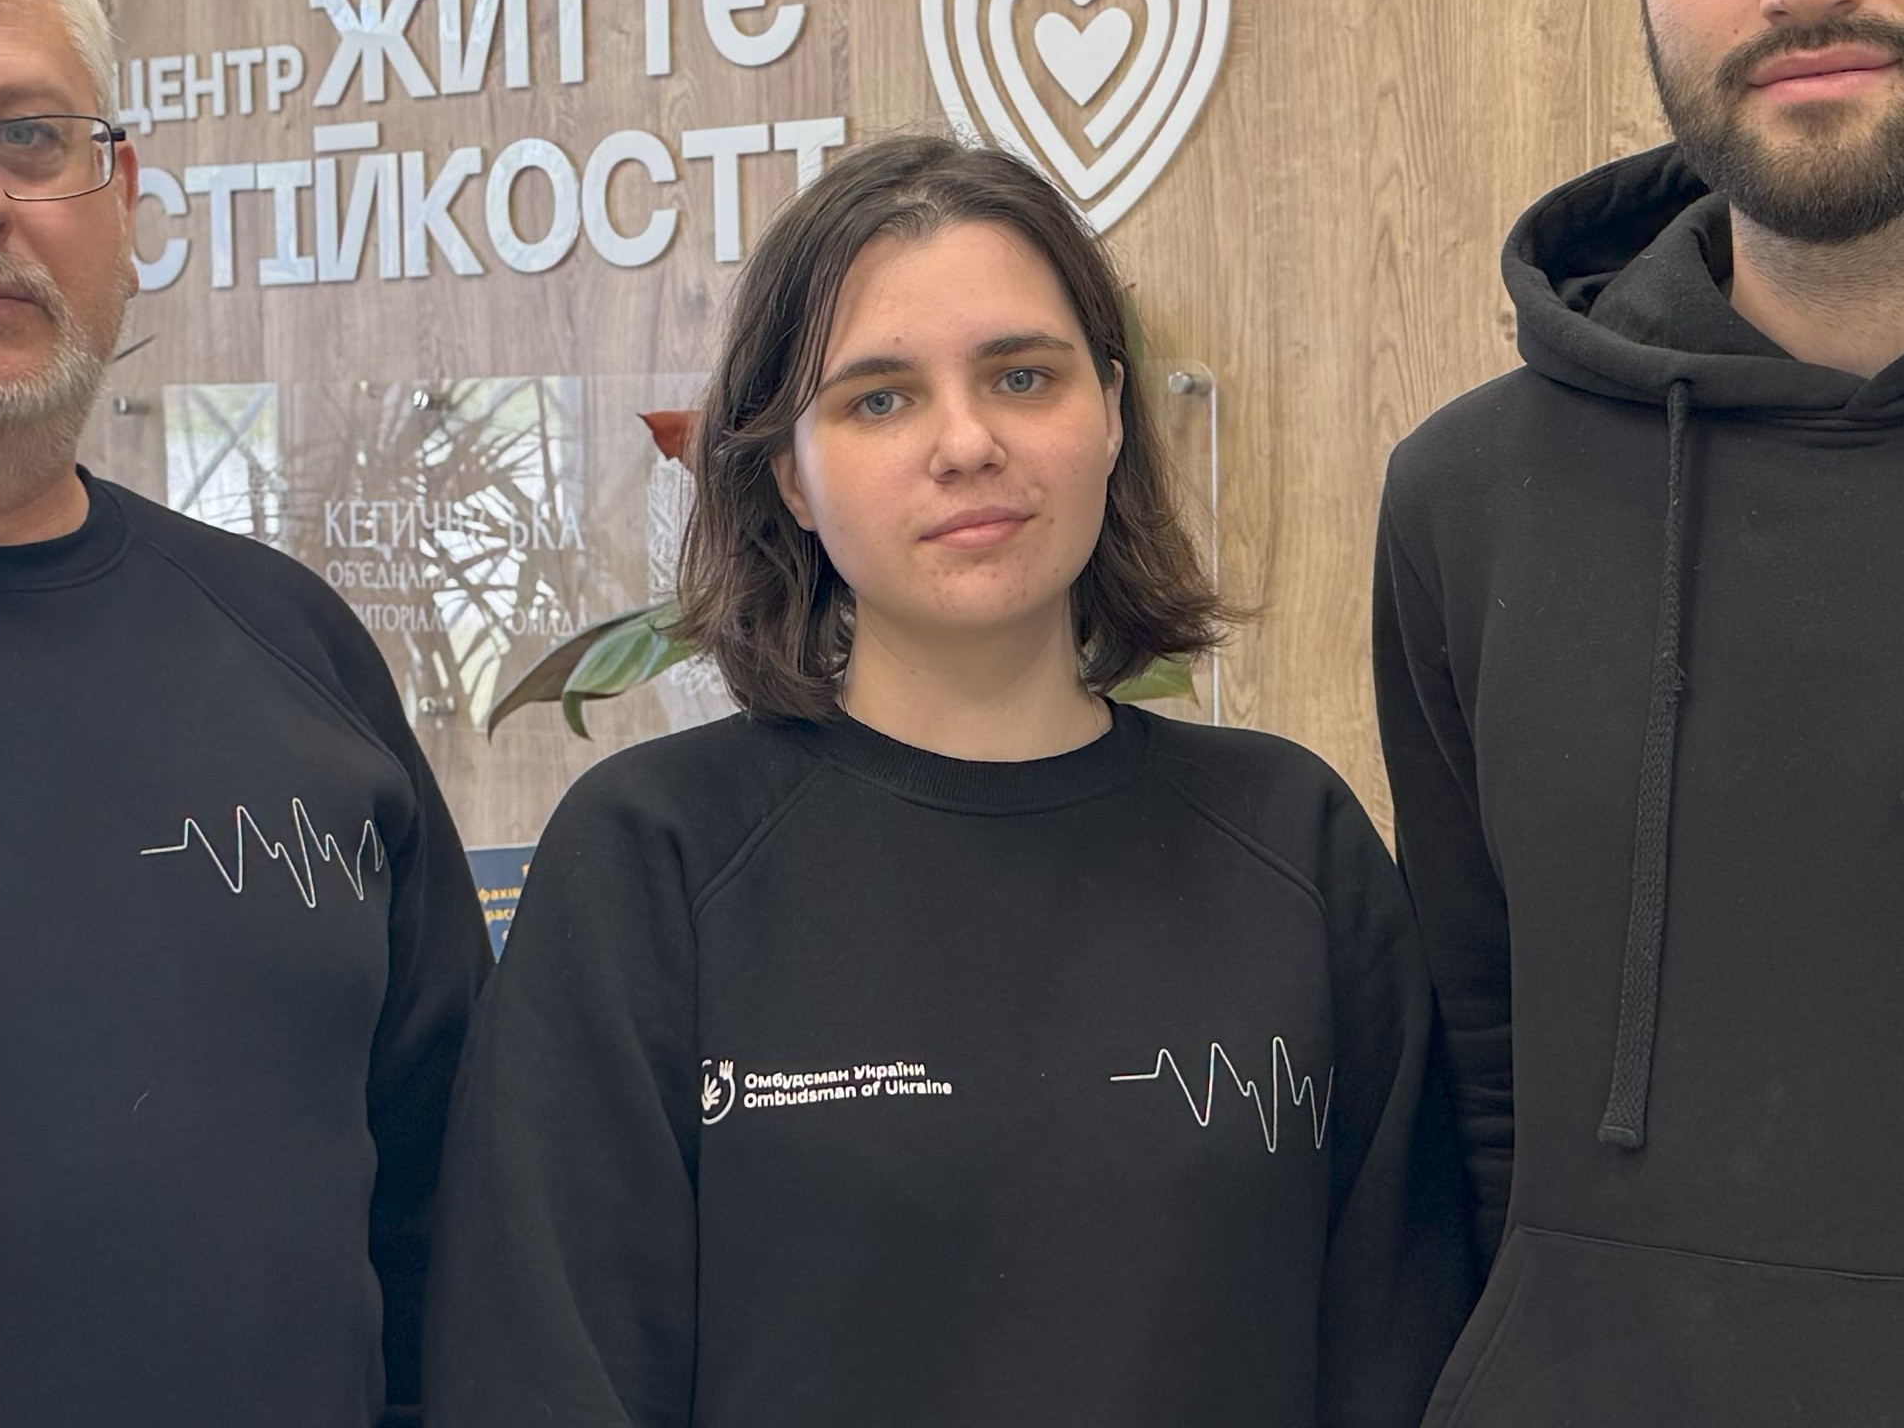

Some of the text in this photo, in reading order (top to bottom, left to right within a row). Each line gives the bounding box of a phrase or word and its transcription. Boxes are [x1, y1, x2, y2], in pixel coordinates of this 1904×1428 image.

[115, 45, 304, 134] ЦЕНТР
[324, 500, 585, 550] КЕГИЧІЬКА
[743, 1079, 953, 1108] Ombudsman of Ukraine
[744, 1062, 925, 1089] Омбудсман України
